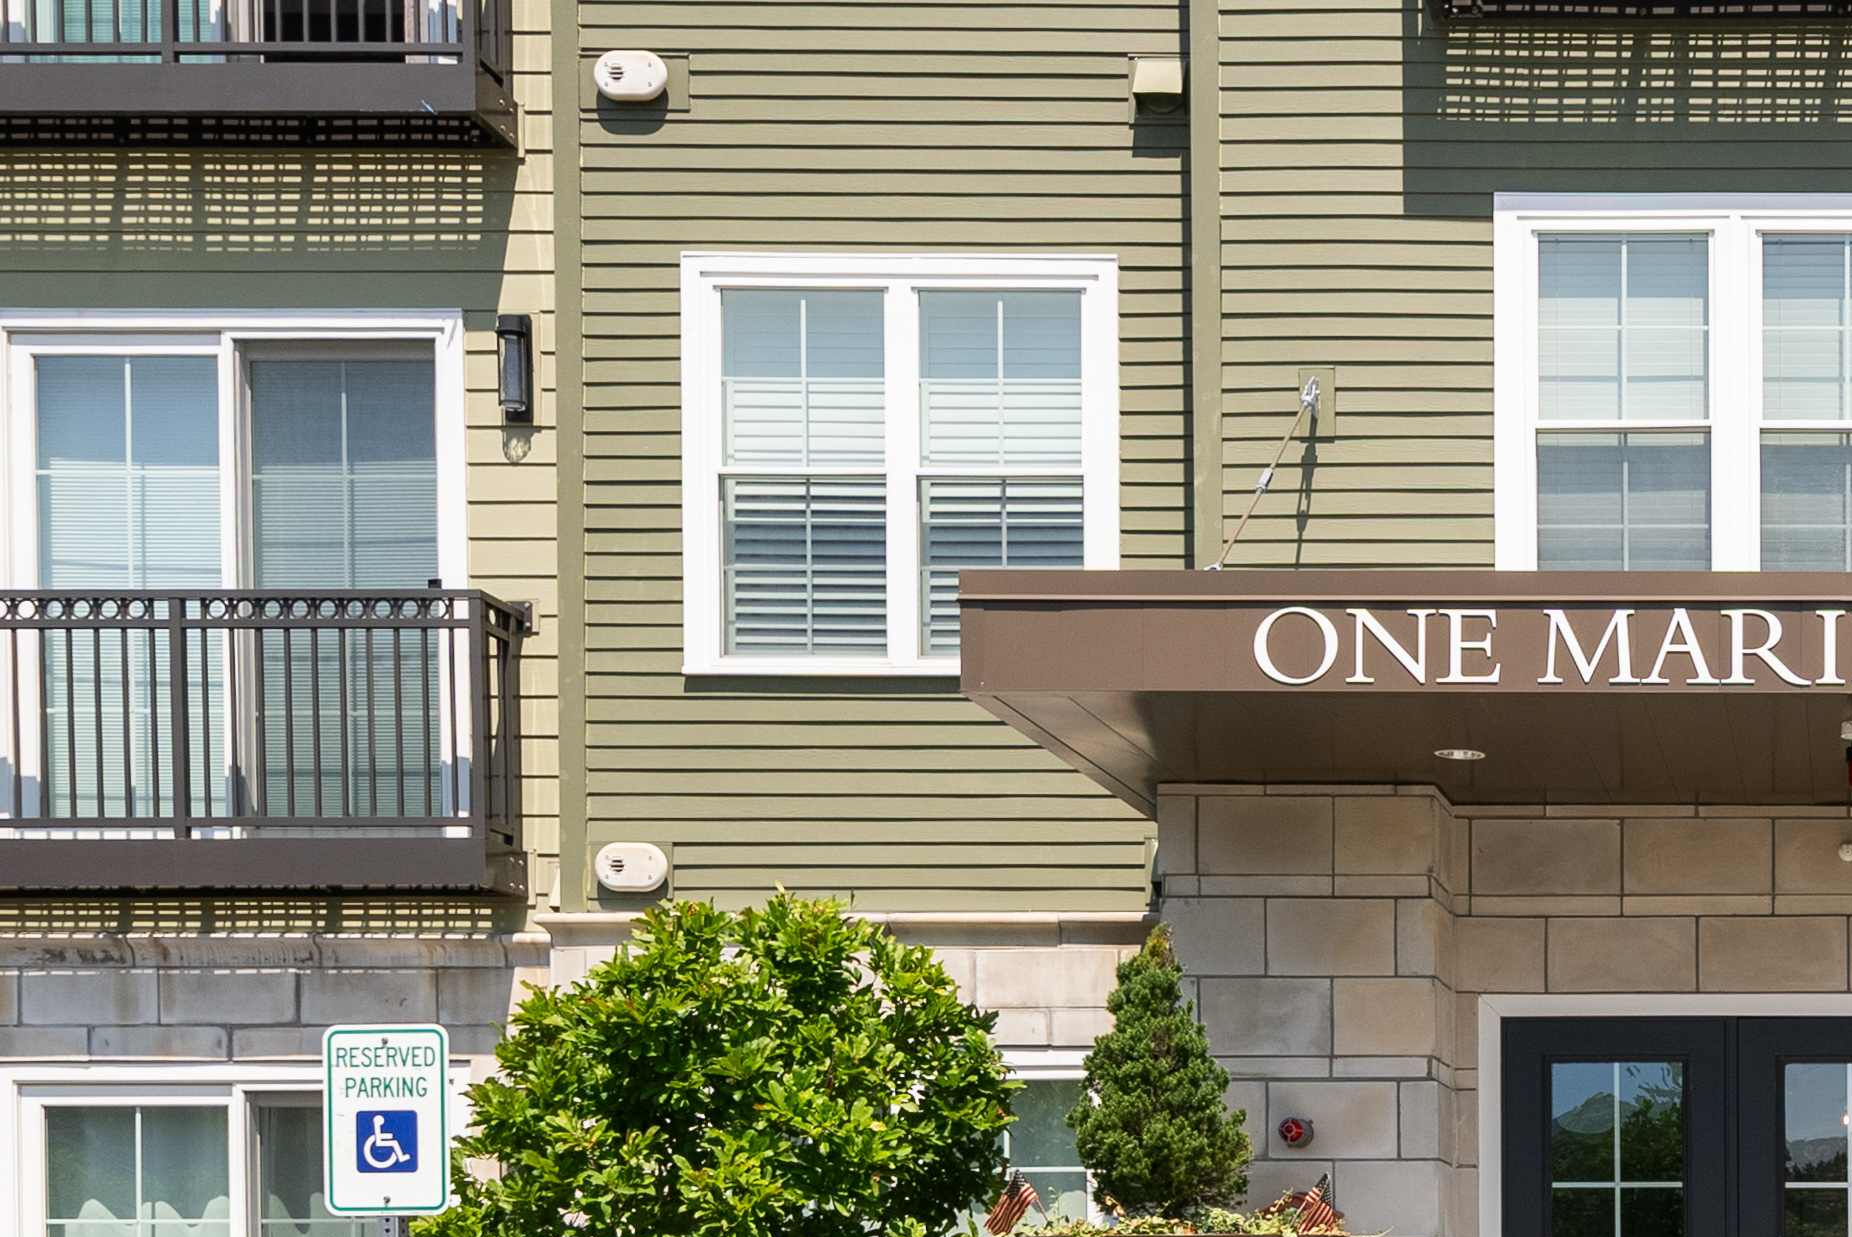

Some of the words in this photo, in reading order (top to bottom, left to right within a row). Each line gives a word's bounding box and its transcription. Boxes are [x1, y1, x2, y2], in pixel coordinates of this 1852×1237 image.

[1253, 606, 1501, 685] ONE
[335, 1046, 436, 1067] RESERVED
[345, 1076, 428, 1098] PARKING
